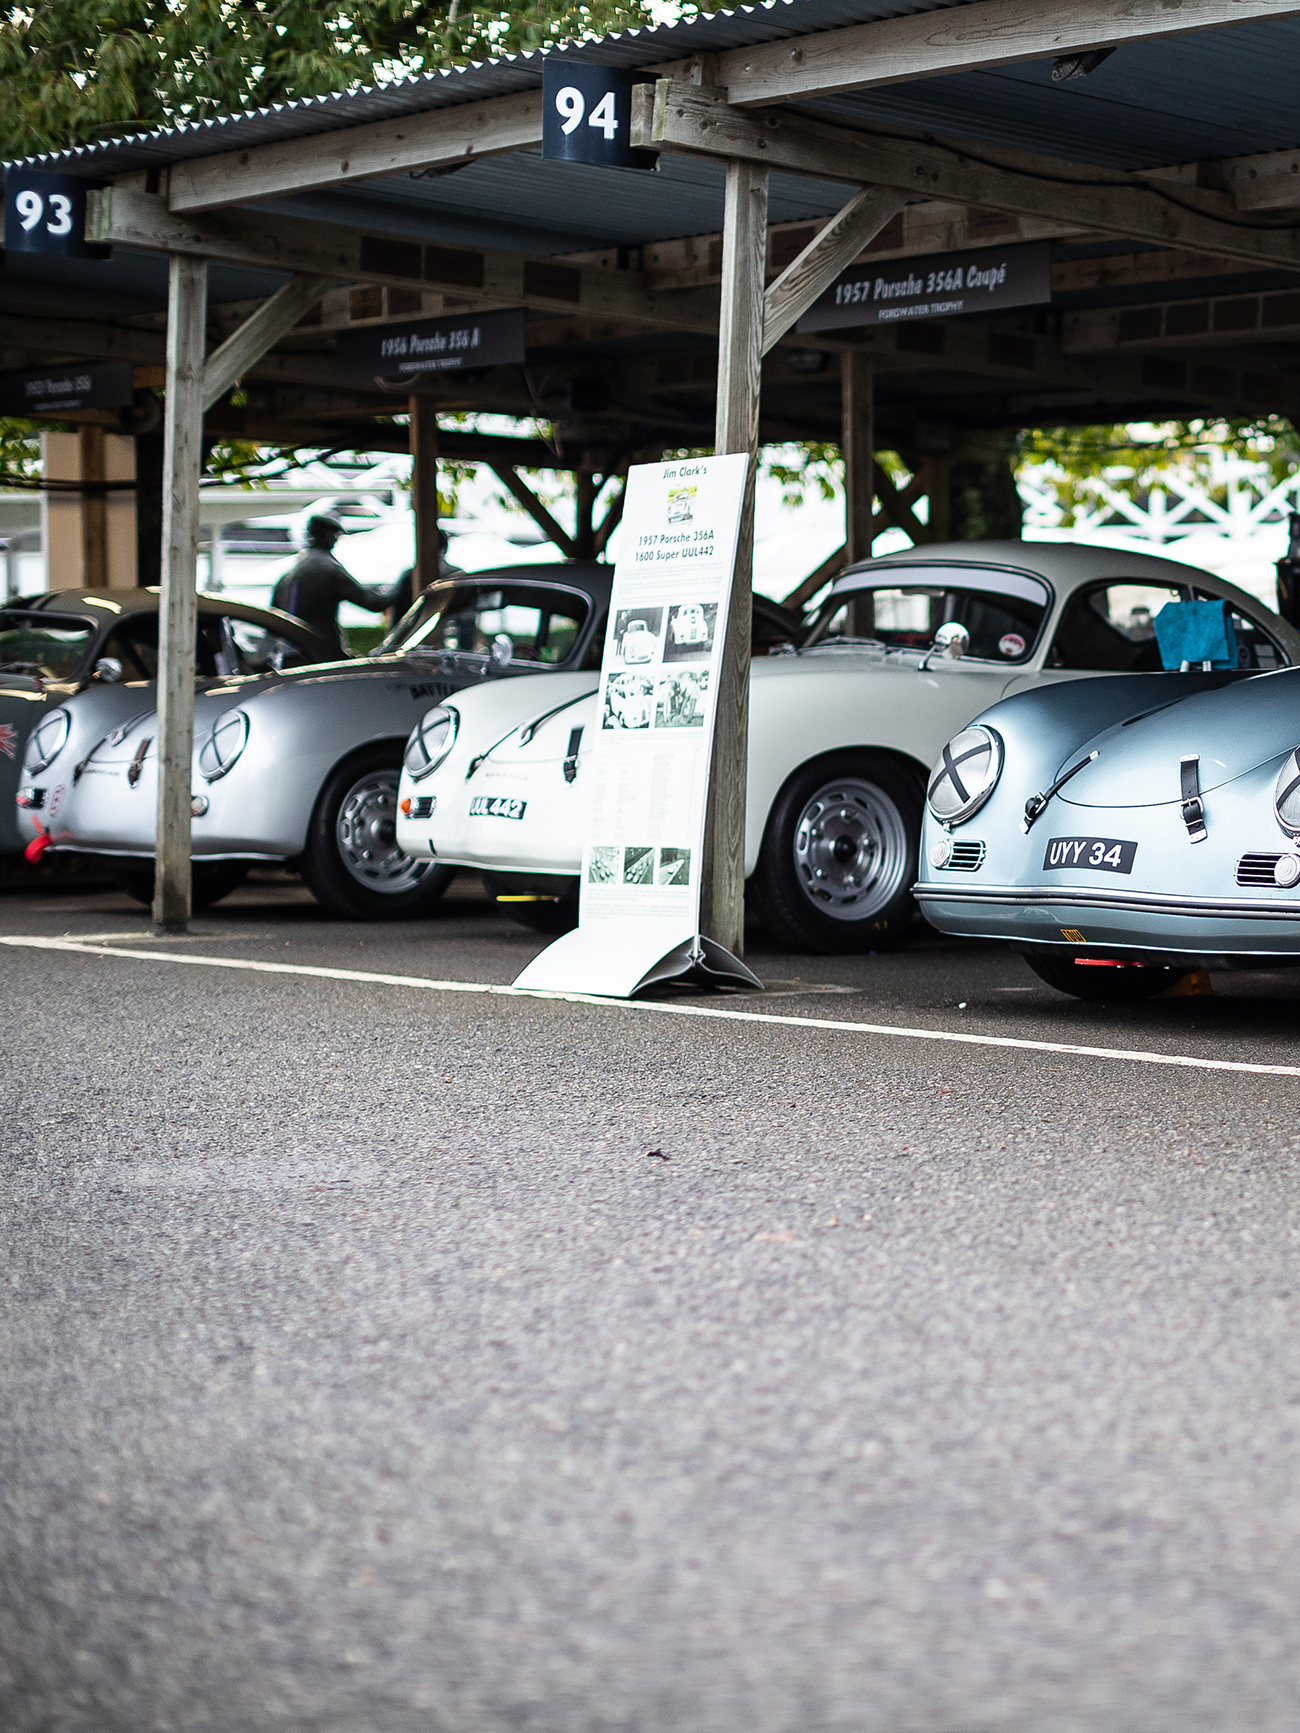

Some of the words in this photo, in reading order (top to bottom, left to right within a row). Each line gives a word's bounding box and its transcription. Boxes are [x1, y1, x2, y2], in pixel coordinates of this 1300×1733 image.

[555, 86, 620, 140] 94
[15, 189, 74, 236] 93
[835, 281, 871, 305] 1957
[873, 273, 923, 301] Porsche
[926, 267, 964, 293] 356A
[966, 263, 1008, 293] Coupé
[663, 468, 677, 480] Jim
[679, 465, 708, 478] Clark's
[639, 534, 658, 547] 1957
[660, 532, 691, 545] Porsche
[693, 530, 715, 542] 356A
[635, 551, 655, 562] 1600
[656, 549, 680, 562] Super
[682, 546, 714, 558] UUL442
[489, 797, 523, 818] 442
[1049, 841, 1087, 865] UYY
[1089, 842, 1123, 867] 34
